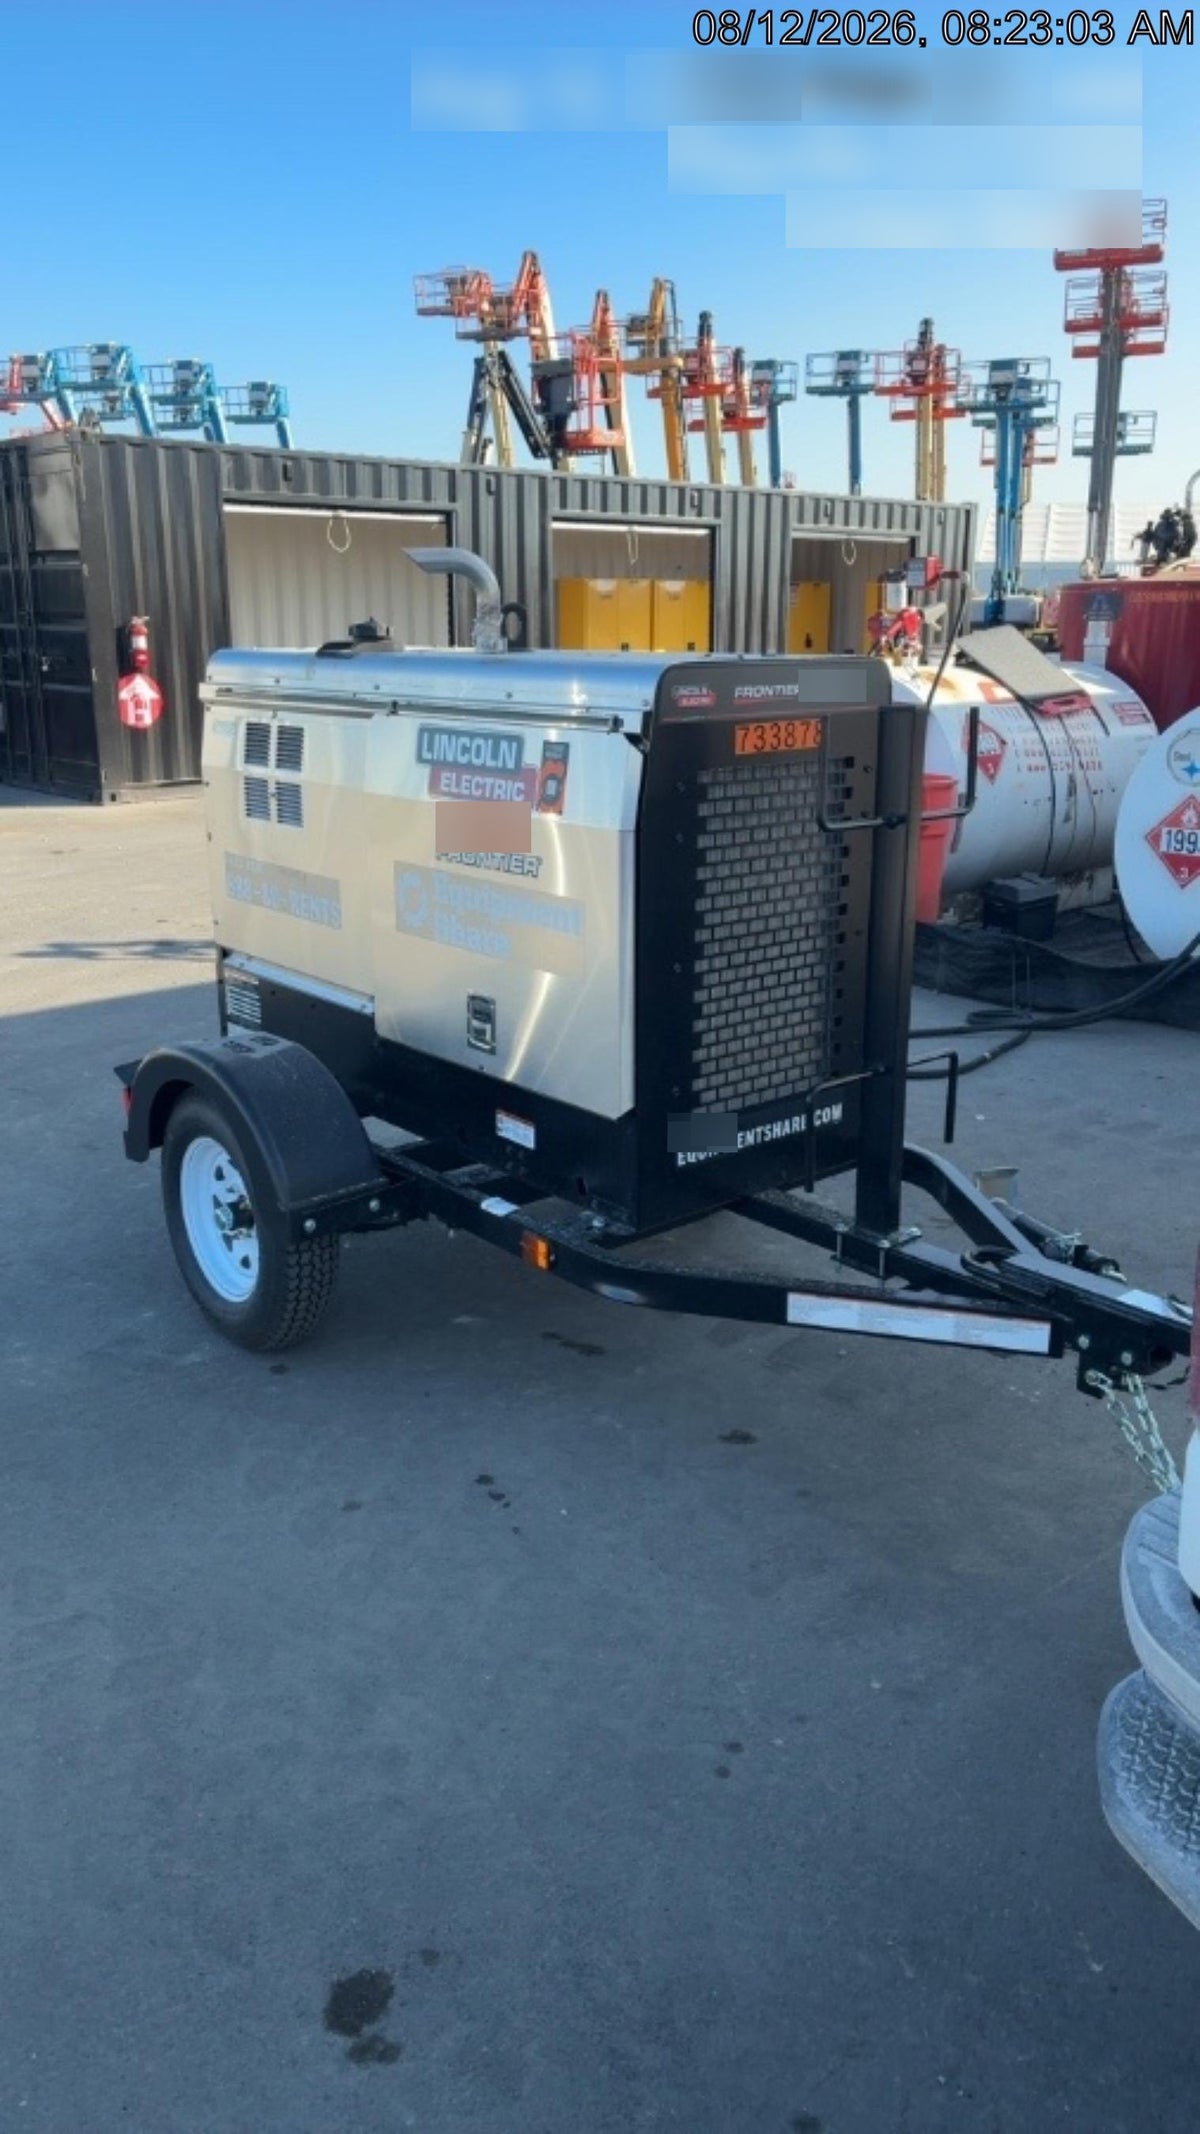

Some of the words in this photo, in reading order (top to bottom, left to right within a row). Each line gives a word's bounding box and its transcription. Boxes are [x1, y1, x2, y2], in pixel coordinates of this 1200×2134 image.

[421, 732, 518, 769] LINCOLN
[440, 772, 525, 801] ELECTRIC
[1165, 829, 1200, 854] 199
